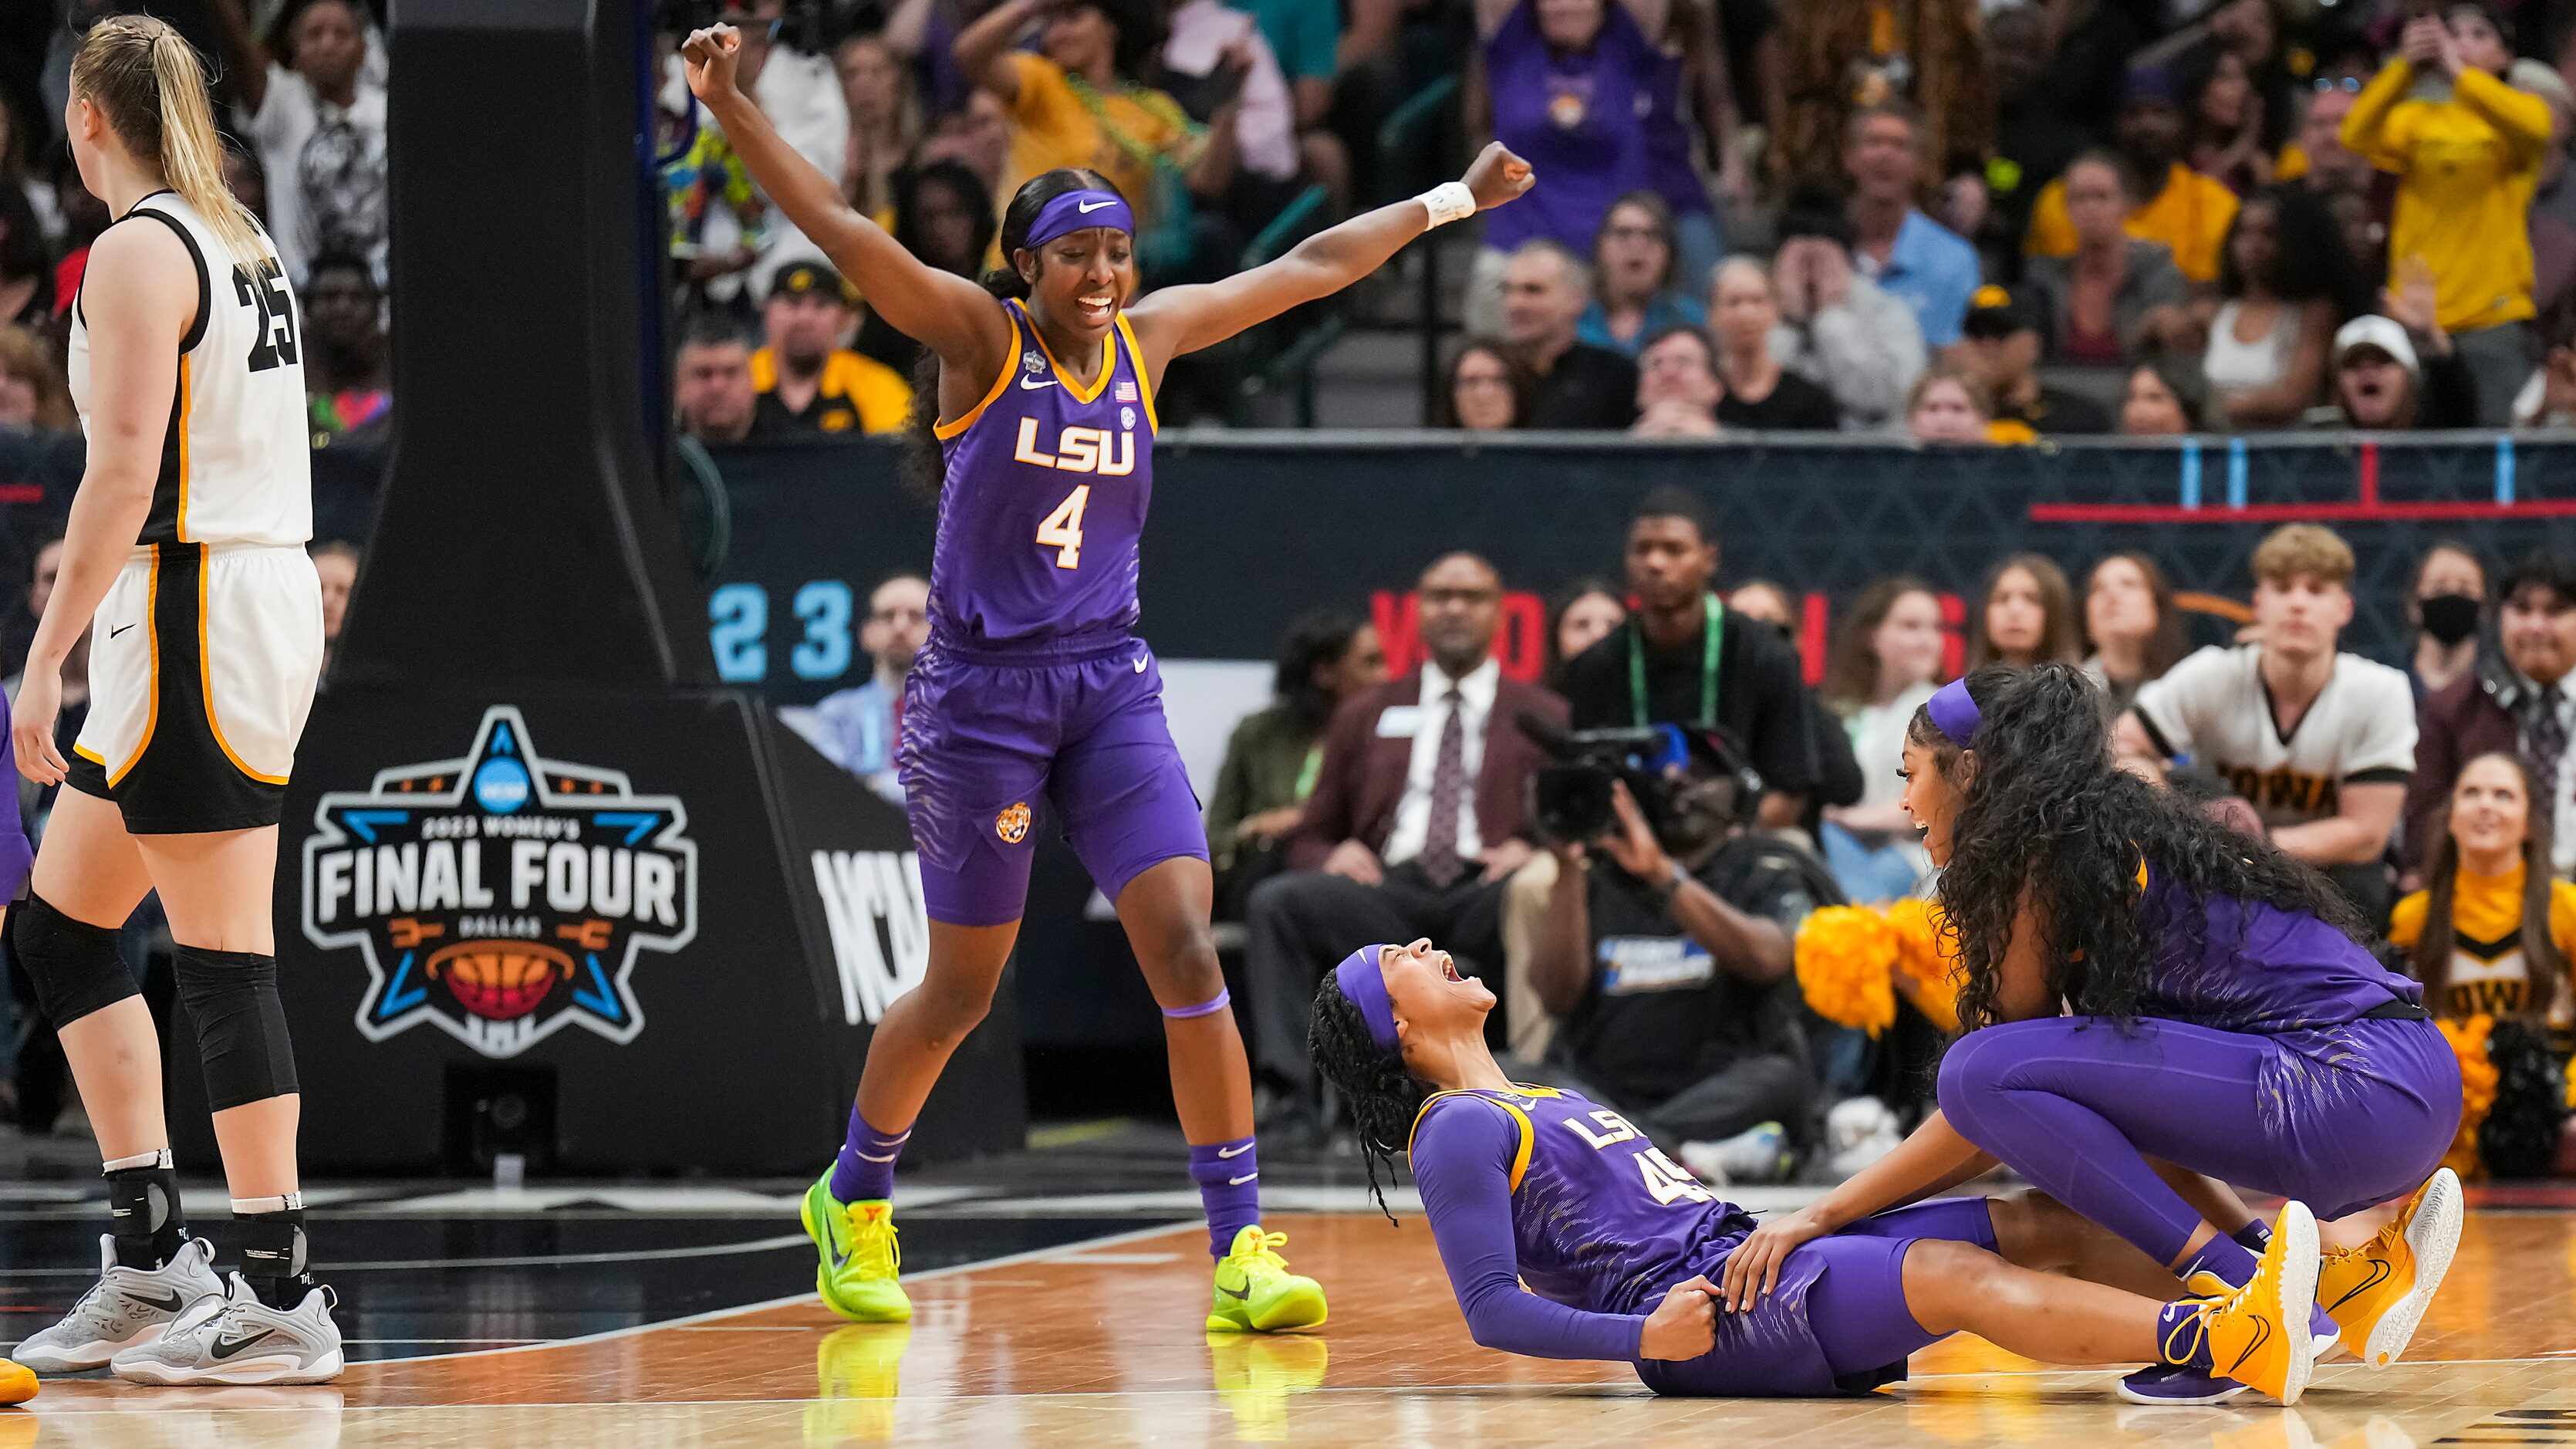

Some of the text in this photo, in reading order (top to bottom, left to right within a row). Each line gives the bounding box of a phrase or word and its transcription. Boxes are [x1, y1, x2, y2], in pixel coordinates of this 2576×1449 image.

[232, 256, 298, 372] 25
[1014, 416, 1135, 475] LSU
[1035, 484, 1090, 569] 4
[421, 814, 581, 841] 2023 WOMEN'S
[318, 839, 678, 927] FINAL FOUR
[458, 915, 542, 939] DALLAS
